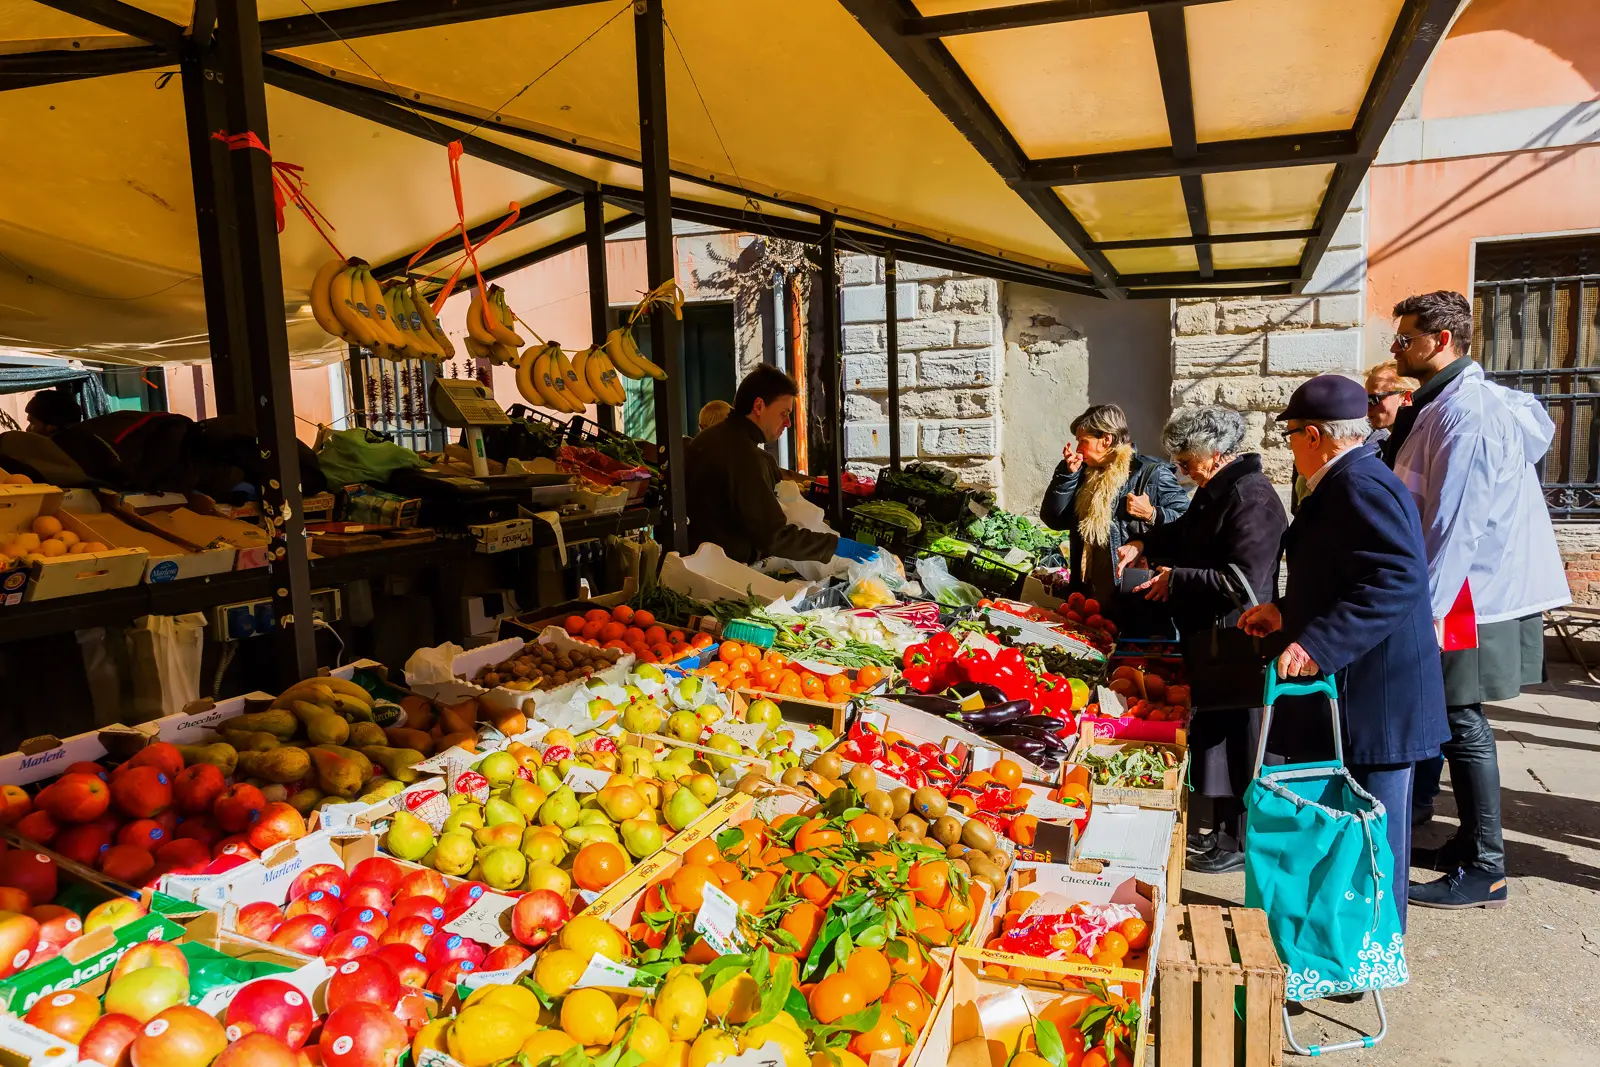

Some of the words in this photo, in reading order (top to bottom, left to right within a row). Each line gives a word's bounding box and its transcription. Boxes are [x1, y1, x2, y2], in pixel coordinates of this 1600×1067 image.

[502, 532, 528, 546] Melinda
[177, 712, 222, 731] Checchin
[18, 748, 66, 771] Marlene
[1102, 788, 1143, 798] SPADONI
[262, 857, 303, 885] Marlene
[1061, 874, 1111, 888] Checchin
[453, 910, 478, 928] ROYAL
[23, 942, 138, 1011] MelaPi
